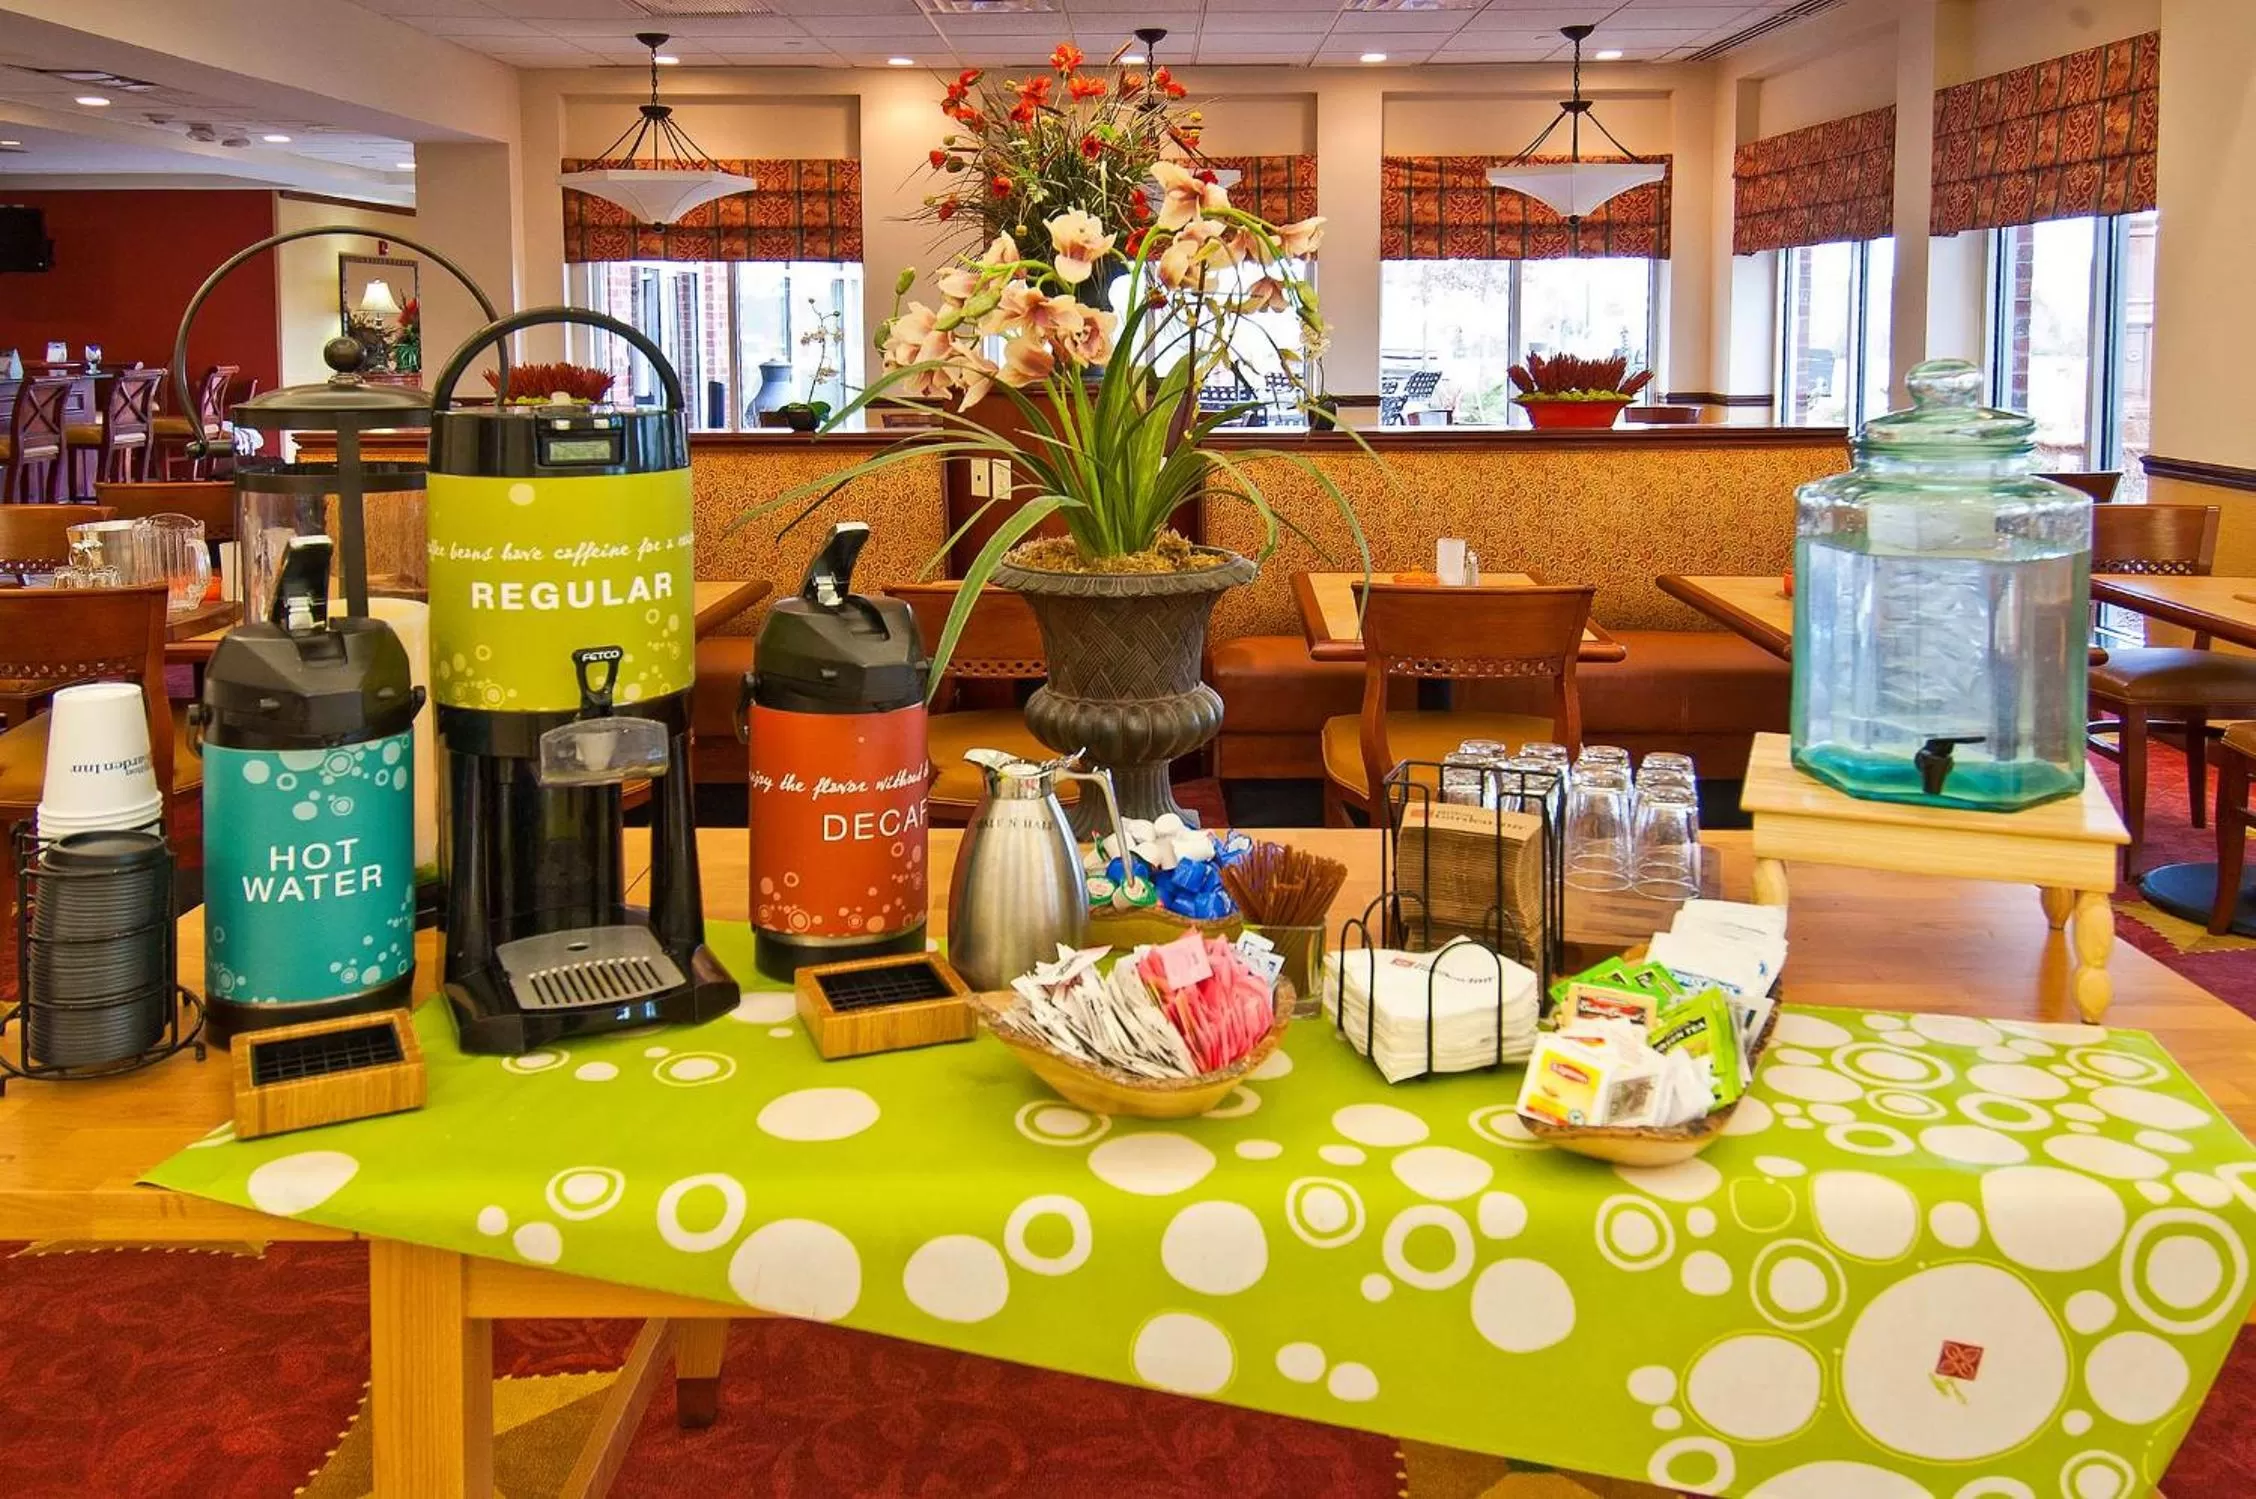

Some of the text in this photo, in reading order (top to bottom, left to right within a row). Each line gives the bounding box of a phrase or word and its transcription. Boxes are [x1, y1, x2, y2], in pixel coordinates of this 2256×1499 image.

[449, 541, 494, 562] beans
[500, 541, 544, 562] have
[553, 540, 631, 568] caffeine
[636, 536, 661, 562] for
[471, 571, 673, 611] REGULAR
[581, 649, 620, 662] FETCO
[104, 755, 146, 772] arden
[779, 772, 807, 793] the
[811, 776, 870, 802] flavor
[823, 798, 928, 842] DECAF
[269, 836, 360, 872] HOT
[241, 863, 383, 903] WATER
